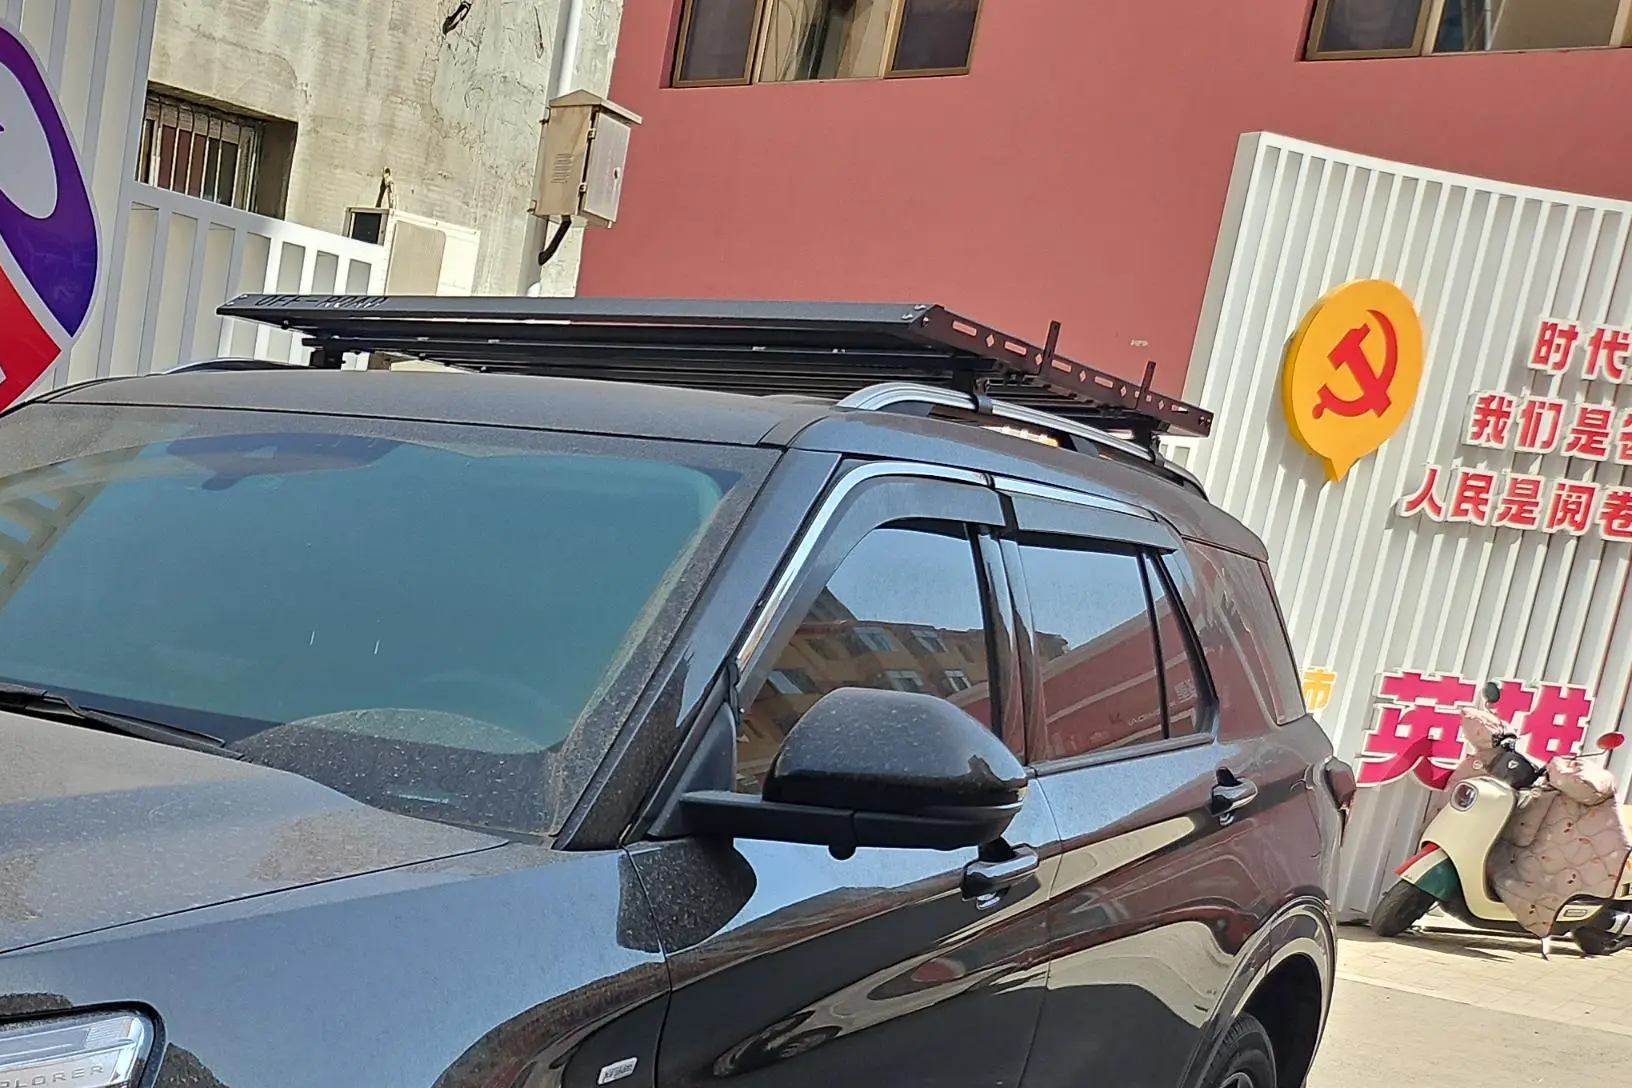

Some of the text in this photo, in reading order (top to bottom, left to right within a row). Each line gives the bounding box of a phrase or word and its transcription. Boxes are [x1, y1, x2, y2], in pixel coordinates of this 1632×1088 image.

[1534, 319, 1632, 379] 时代
[1405, 465, 1632, 538] 人民是阅卷
[1356, 670, 1593, 790] 英雄
